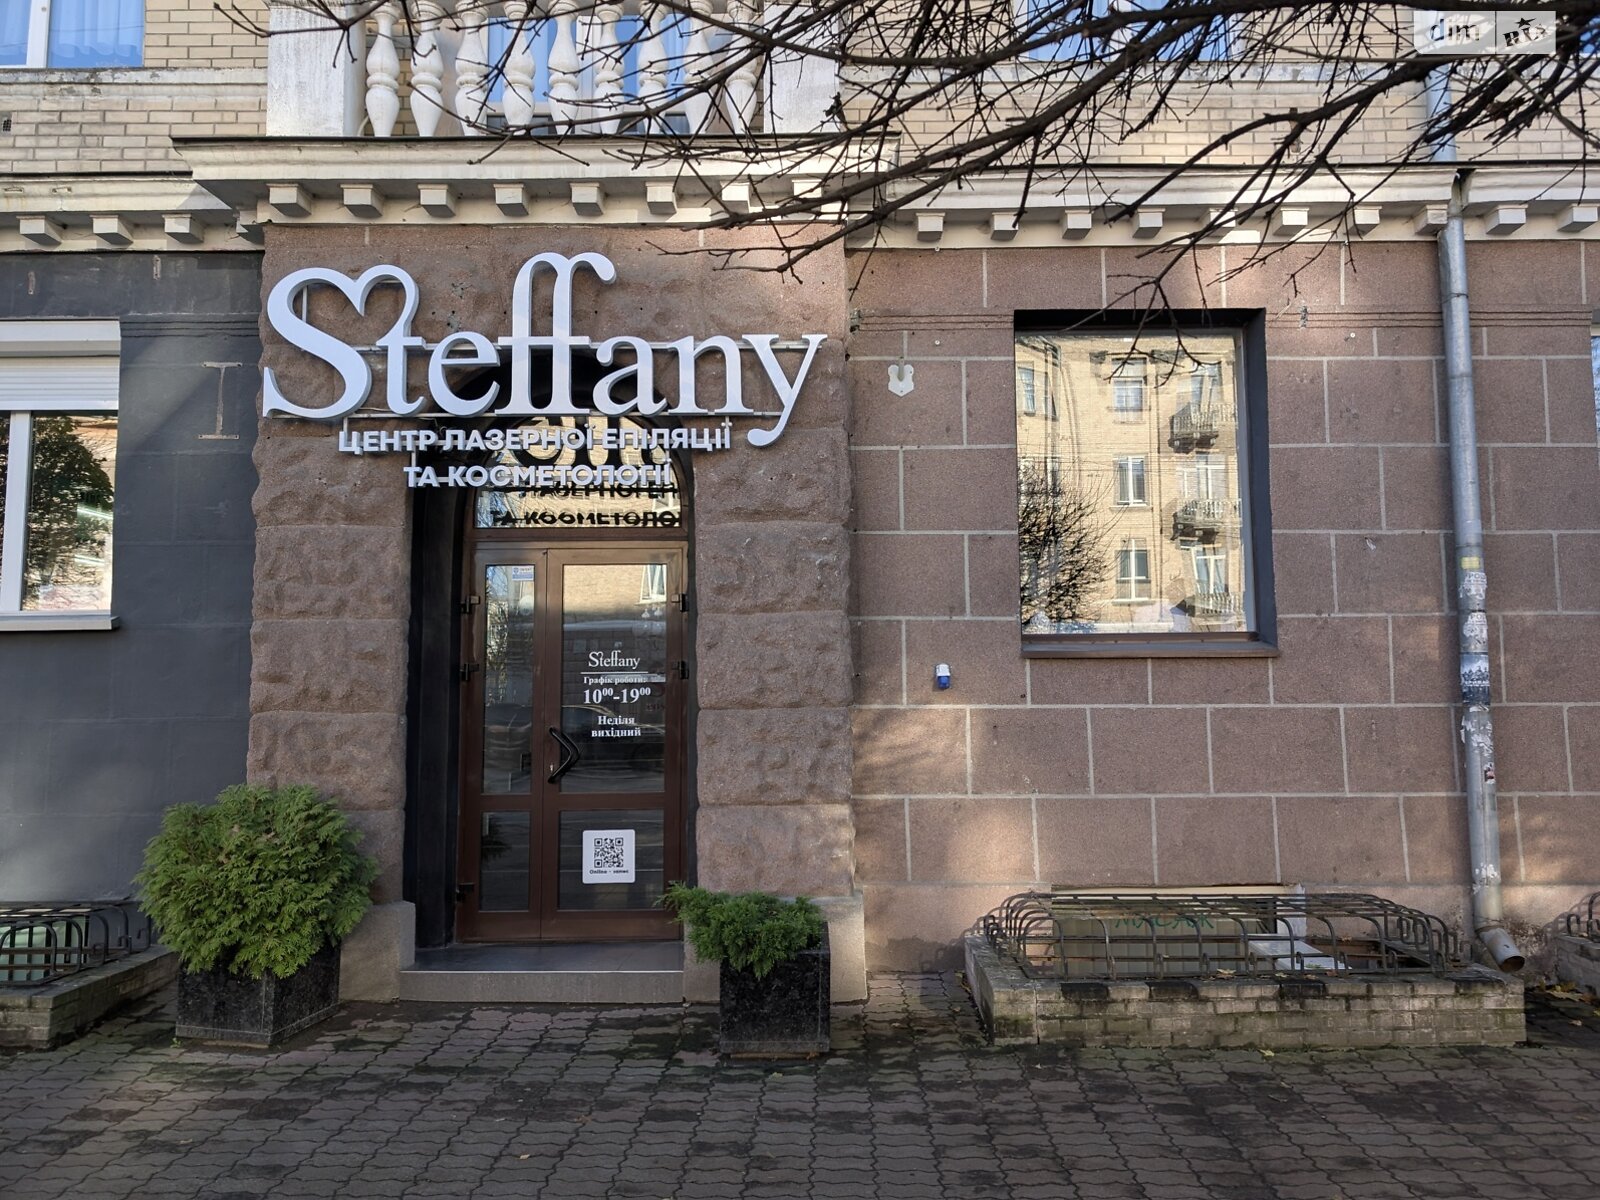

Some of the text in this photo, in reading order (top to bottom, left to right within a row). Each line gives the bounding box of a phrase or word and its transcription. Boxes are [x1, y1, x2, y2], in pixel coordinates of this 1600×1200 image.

[263, 252, 828, 447] Steffany
[338, 421, 732, 455] ЦЕНТР ЛАЗЕРНОЇ ЕПІЛЯЦІЇ
[403, 458, 673, 488] ТА КОСМЕТОЛОГІЇ
[588, 650, 640, 669] Steffany
[583, 676, 613, 685] Графік
[598, 715, 635, 725] Неділя
[591, 727, 641, 737] вихідний
